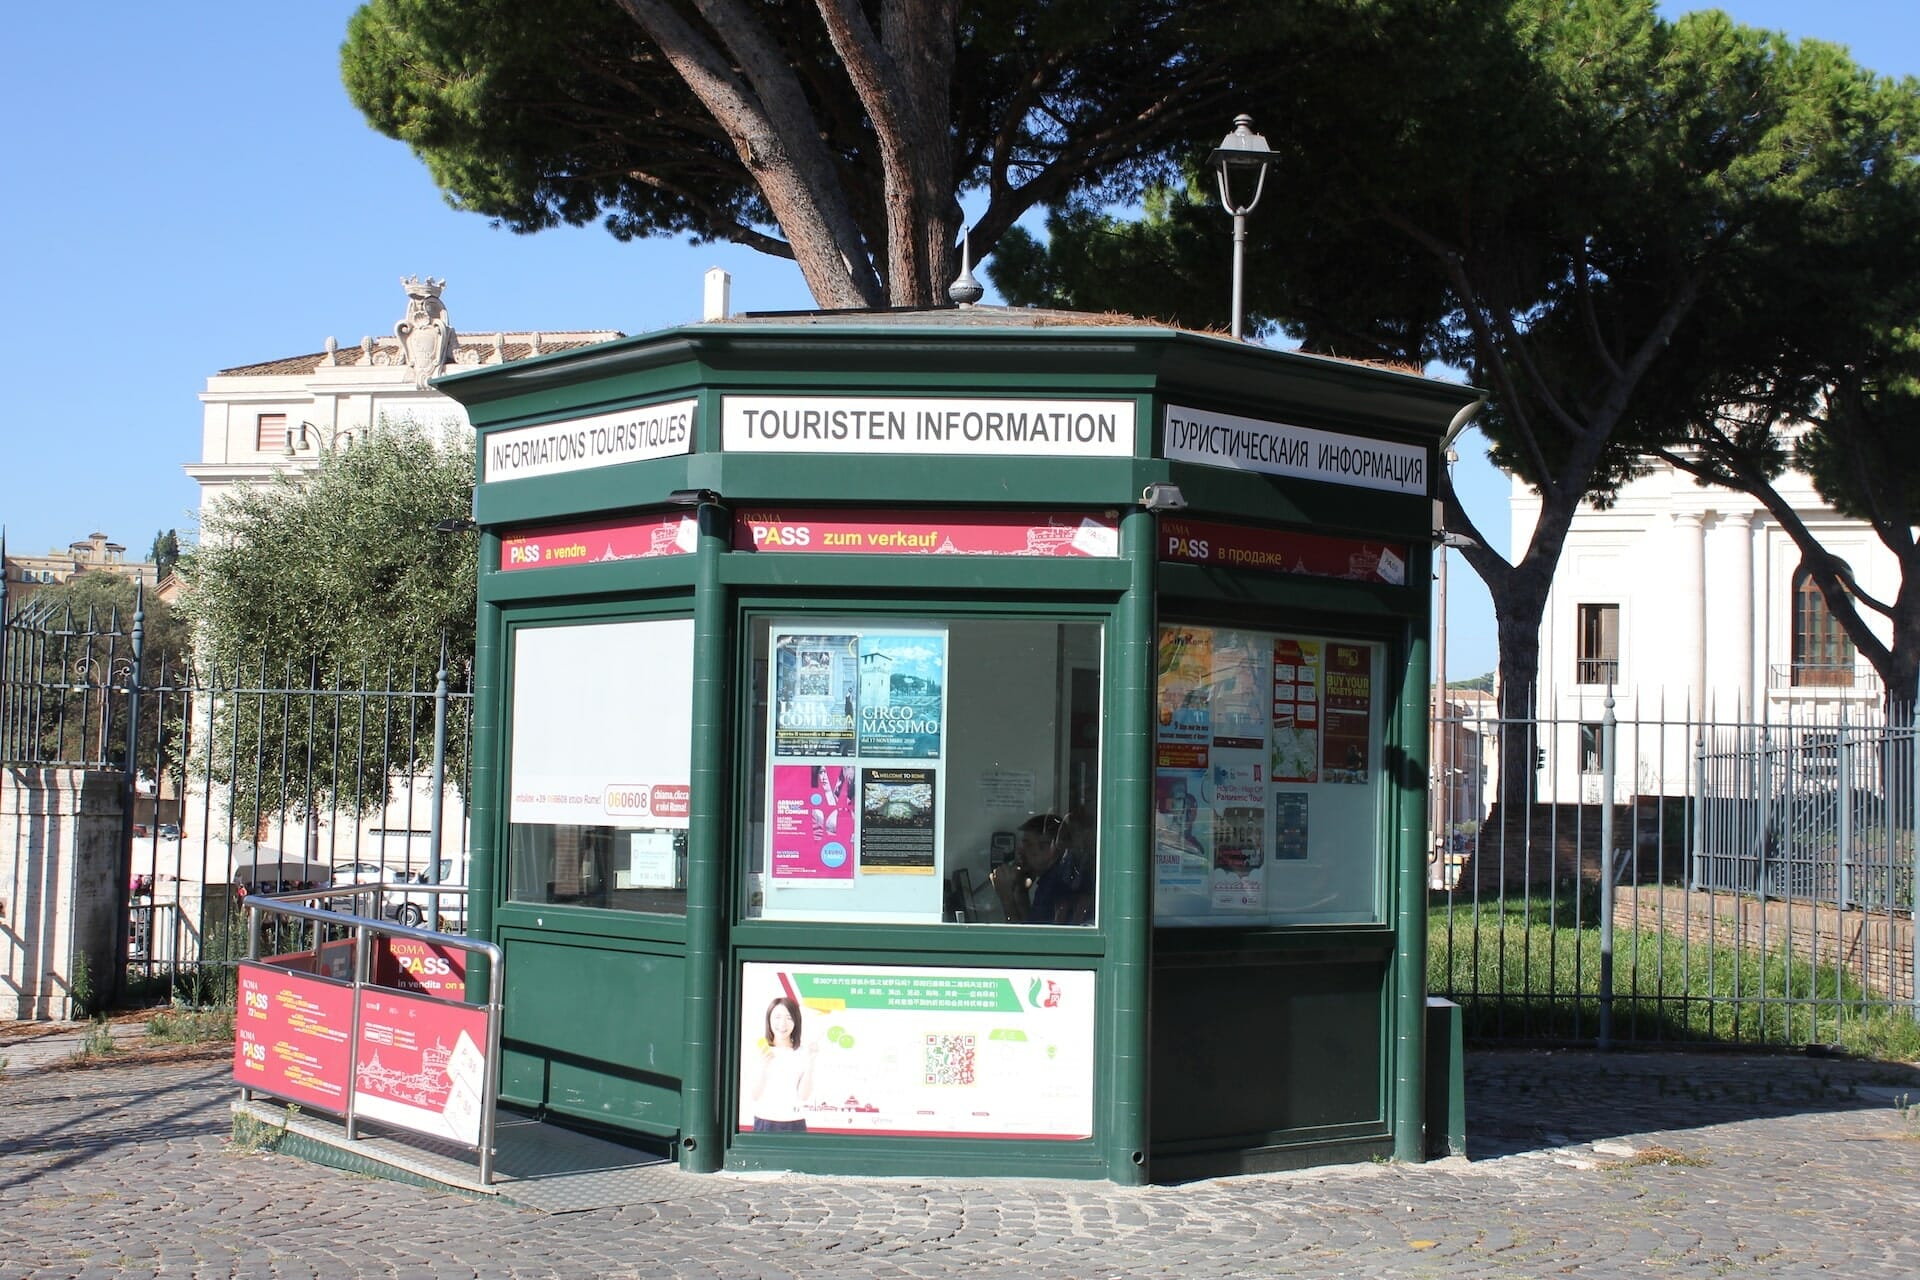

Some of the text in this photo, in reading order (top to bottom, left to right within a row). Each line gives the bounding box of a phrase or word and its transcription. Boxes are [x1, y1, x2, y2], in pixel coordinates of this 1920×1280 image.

[742, 409, 1116, 443] TOURISTEN INFORMATION
[493, 414, 687, 472] INFORMATIONS TOURISTIQUES
[1318, 443, 1423, 487] ИНФОРМАЦИЯ
[743, 513, 782, 525] ROMA
[753, 526, 938, 547] PASS zum verkauf
[510, 544, 587, 564] PASS a vendre
[1169, 537, 1209, 559] PASS
[1218, 548, 1282, 566] в продаже
[1327, 675, 1369, 689] BUY YOUR
[862, 705, 913, 720] CIRCO
[862, 719, 938, 734] MASSIMO
[607, 791, 647, 808] 060608
[390, 944, 425, 955] ROMA
[399, 956, 450, 975] PASS
[408, 979, 441, 989] vendita
[445, 982, 457, 990] on
[245, 990, 268, 1010] PASS
[243, 1041, 266, 1061] PASS
